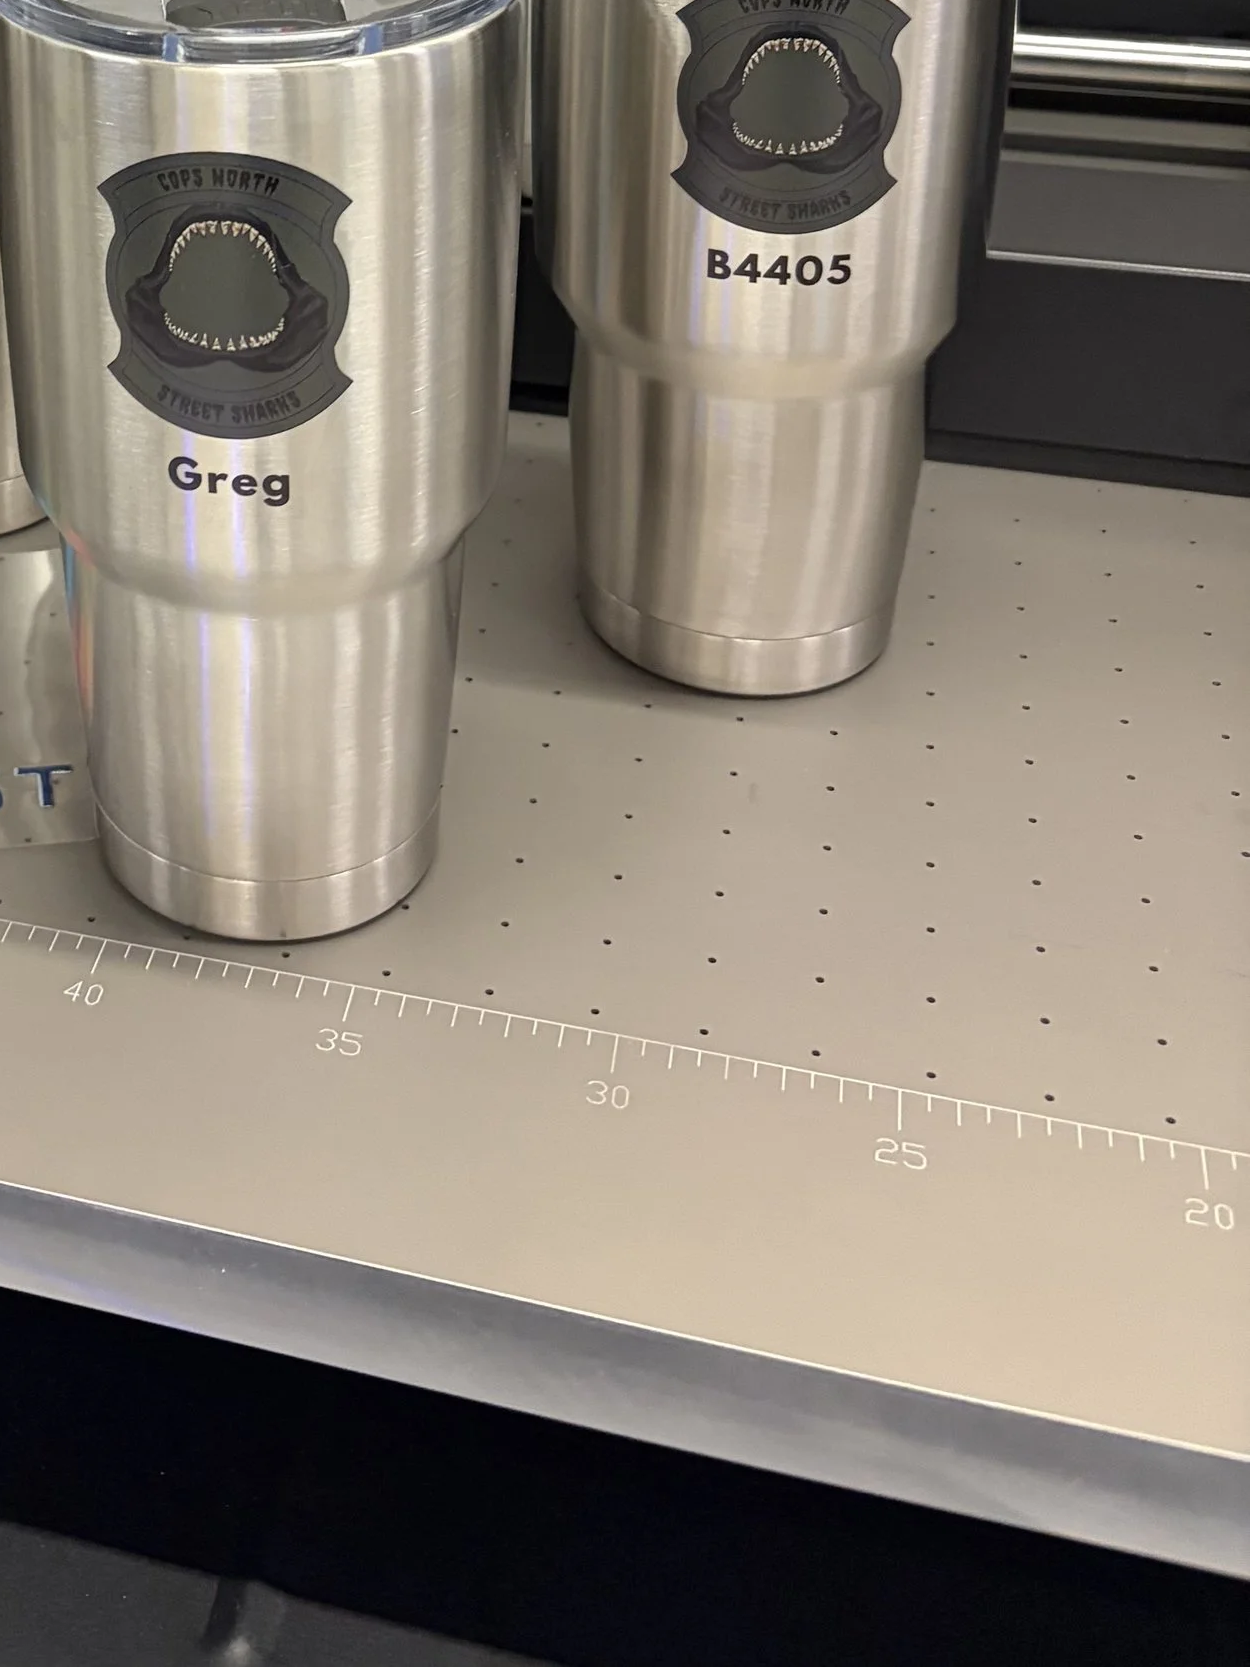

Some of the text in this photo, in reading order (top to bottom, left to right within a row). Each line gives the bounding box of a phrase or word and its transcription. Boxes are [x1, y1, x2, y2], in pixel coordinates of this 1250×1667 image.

[156, 168, 280, 195] COPS NORTH
[719, 187, 851, 221] STREET SHARKS
[707, 248, 852, 286] B4405
[156, 384, 300, 424] STREET SHARKS
[168, 456, 291, 507] Greg
[63, 981, 104, 1006] 40
[315, 1028, 364, 1056] 35
[585, 1080, 630, 1110] 30
[875, 1138, 928, 1170] 25
[1185, 1198, 1235, 1231] 20
